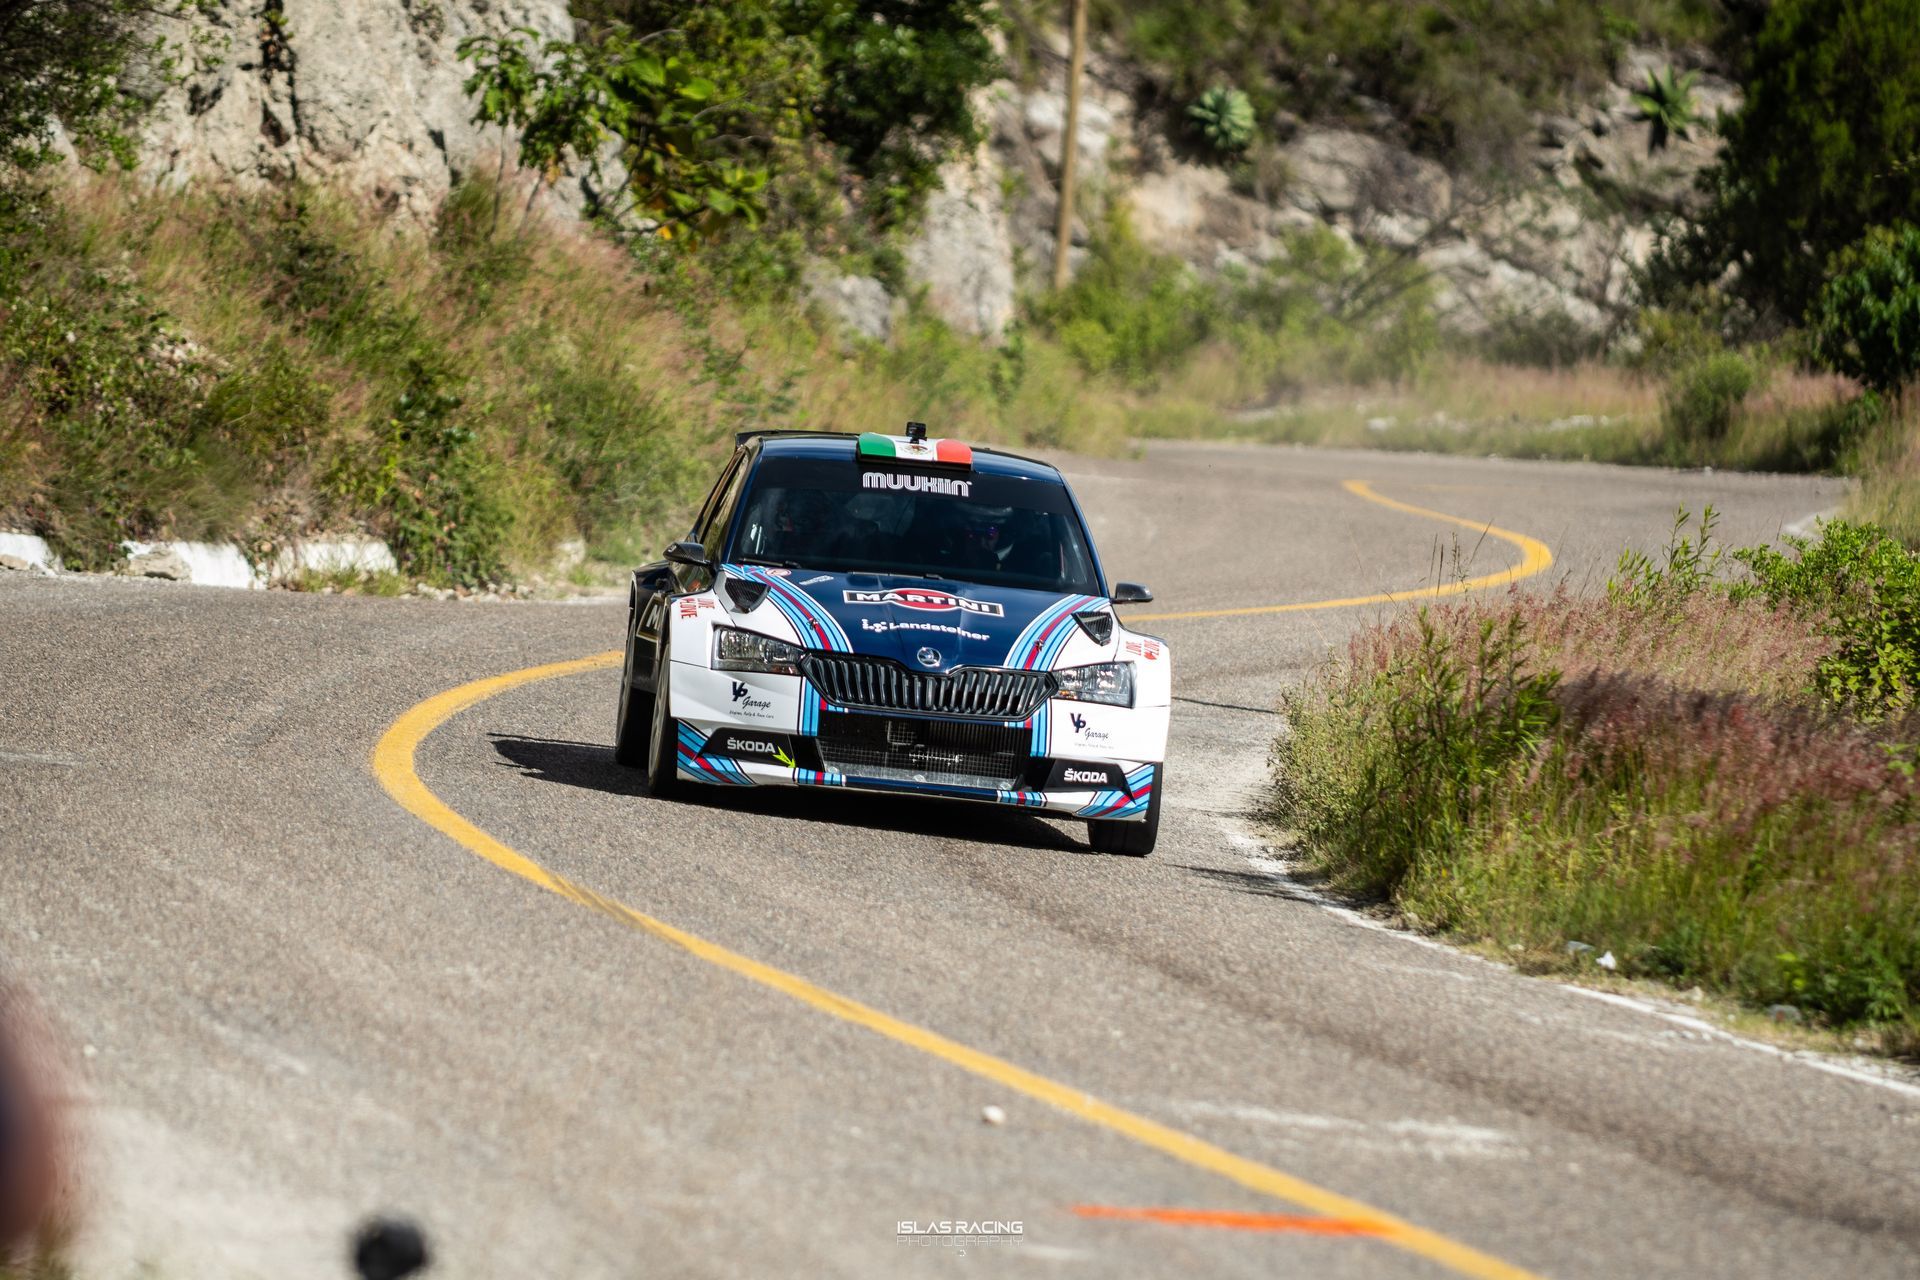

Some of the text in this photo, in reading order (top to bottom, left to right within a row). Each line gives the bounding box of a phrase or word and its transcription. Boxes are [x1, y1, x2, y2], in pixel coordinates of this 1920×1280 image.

[856, 593, 990, 612] MARTINI
[889, 622, 990, 641] Landsteiner
[742, 696, 771, 710] Garage
[1085, 727, 1109, 741] Garage
[727, 737, 776, 754] ŠKODA
[1063, 768, 1108, 784] ŠKODA
